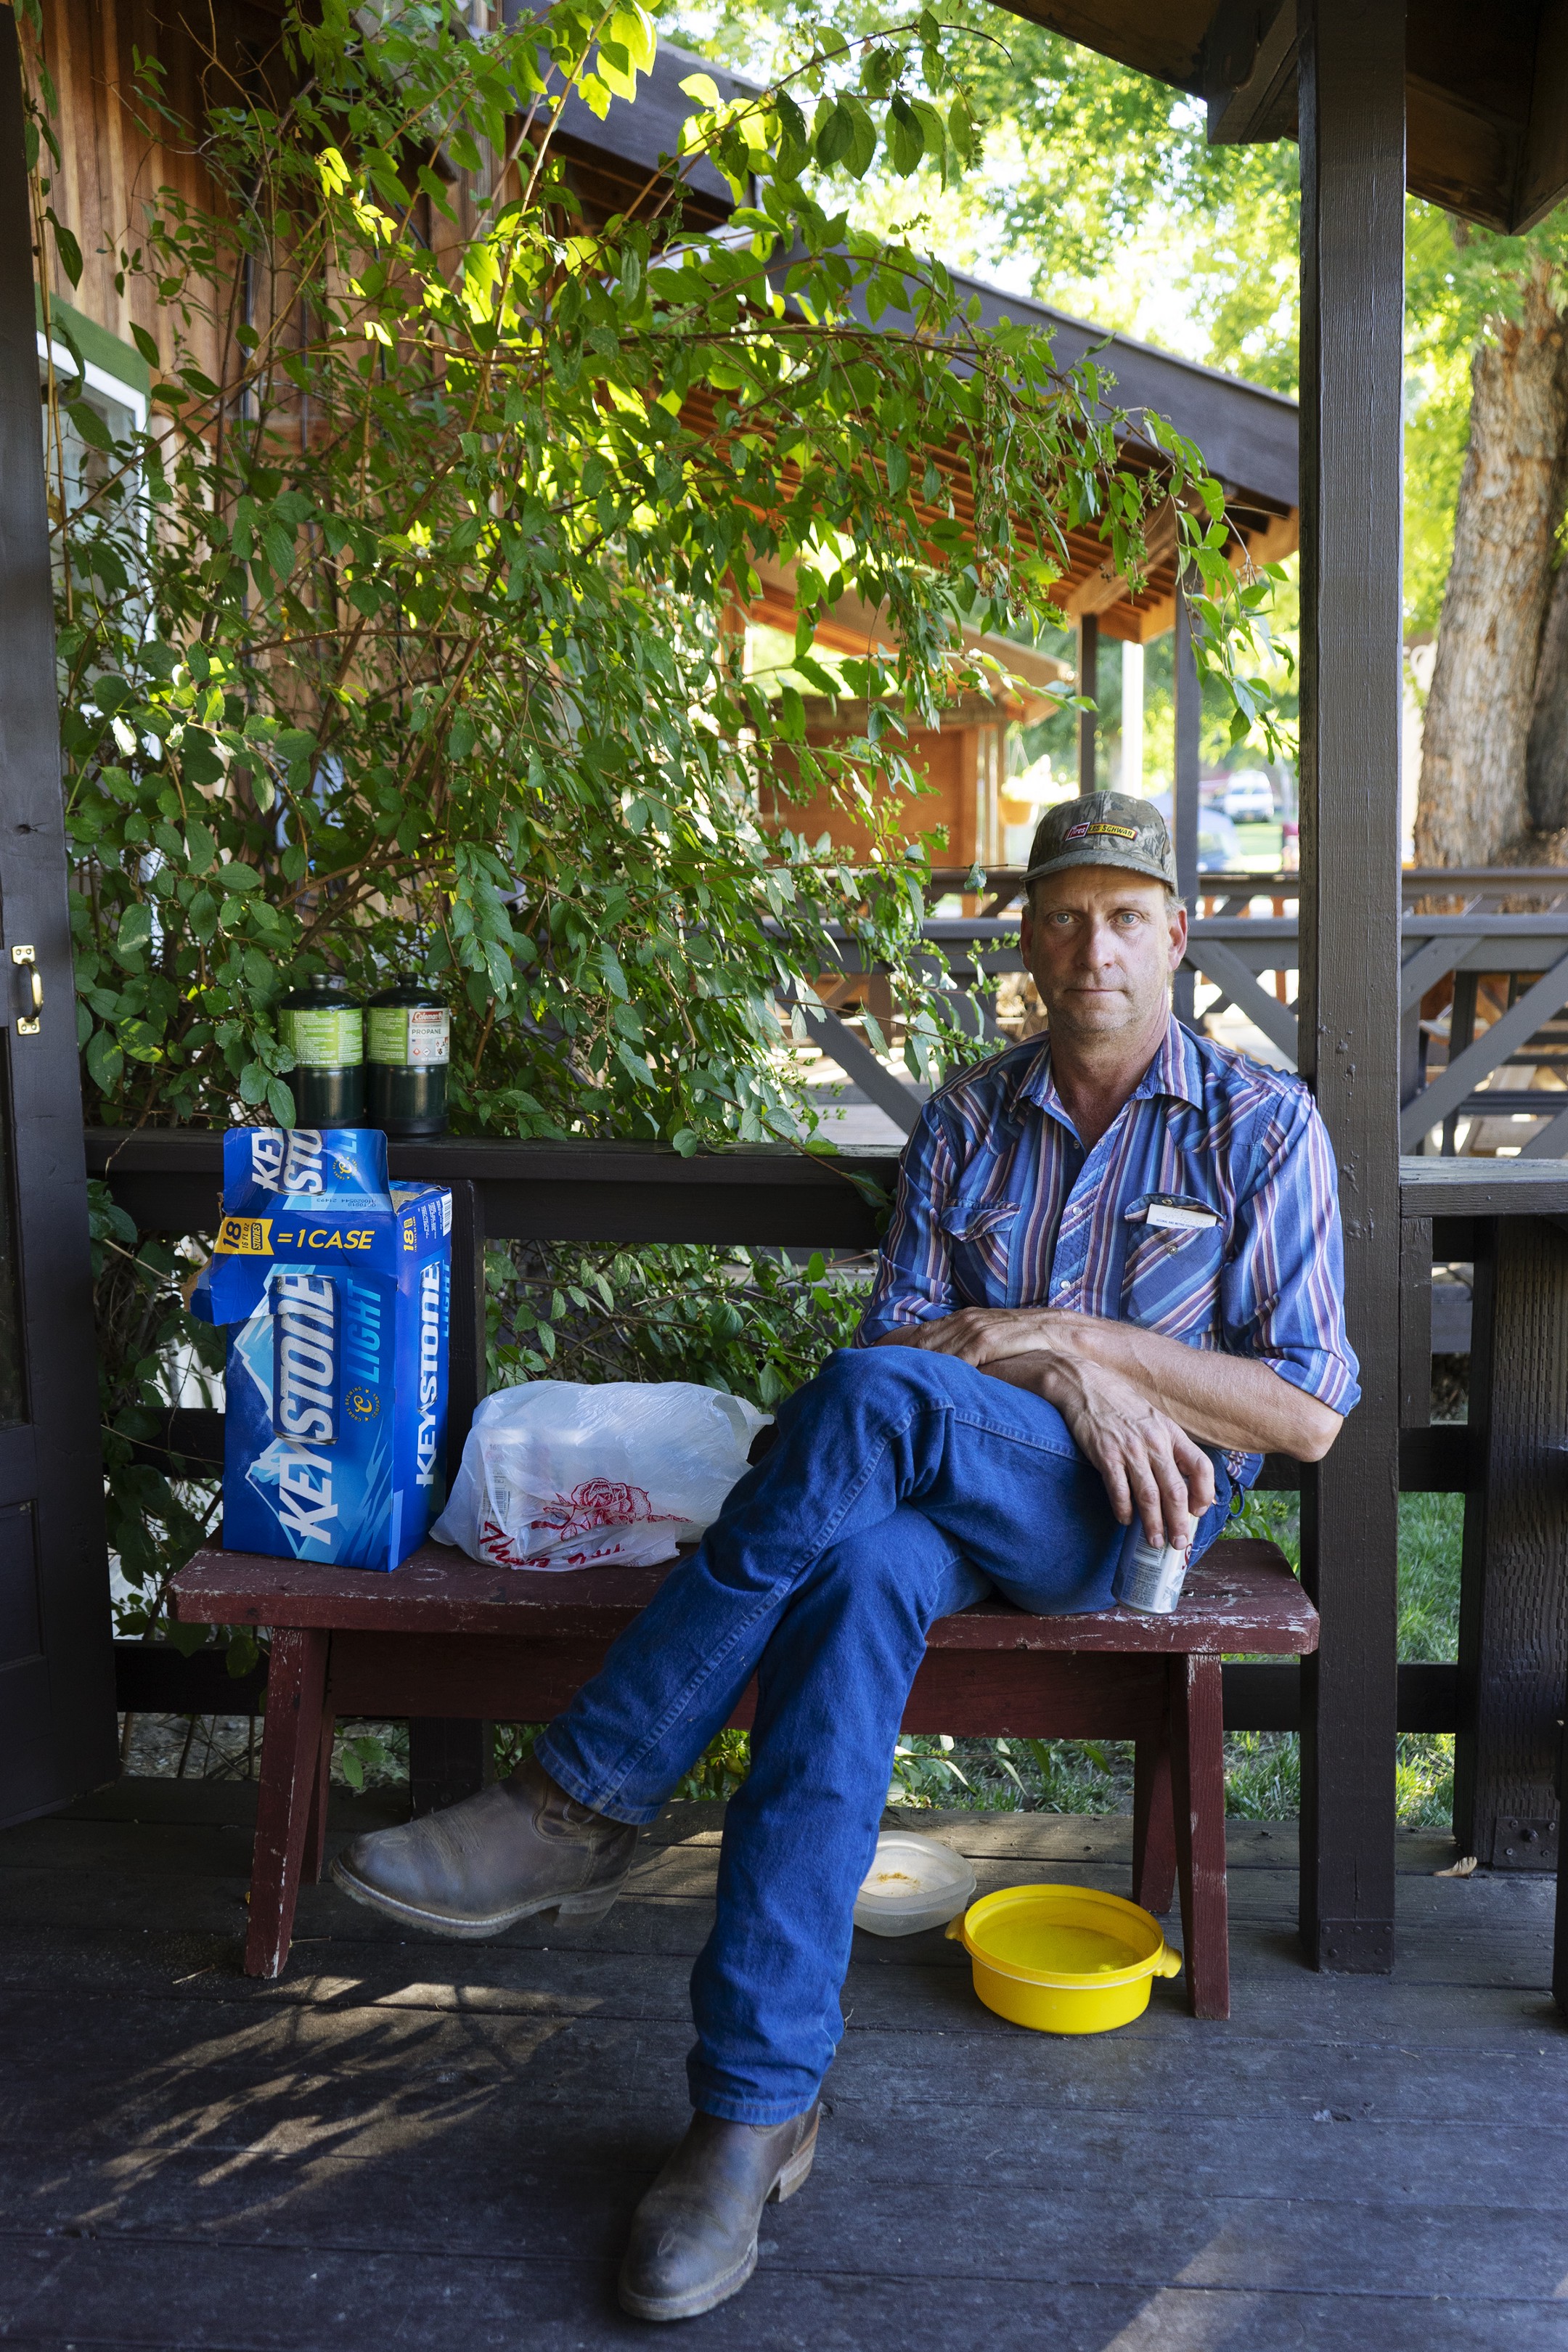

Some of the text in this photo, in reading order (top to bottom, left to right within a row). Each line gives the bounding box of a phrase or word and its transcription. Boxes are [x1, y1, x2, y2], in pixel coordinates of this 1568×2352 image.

[1103, 825, 1133, 837] SCHWAB
[415, 1011, 438, 1021] Coleman
[222, 1220, 242, 1249] 18
[243, 1222, 250, 1232] OZ
[252, 1223, 261, 1250] STONES
[403, 1230, 415, 1251] 18
[441, 1259, 450, 1337] LIGHT
[347, 1278, 381, 1384] LIGHT
[416, 1264, 440, 1488] KEYSTONE
[278, 1276, 338, 1545] KEYSTONE
